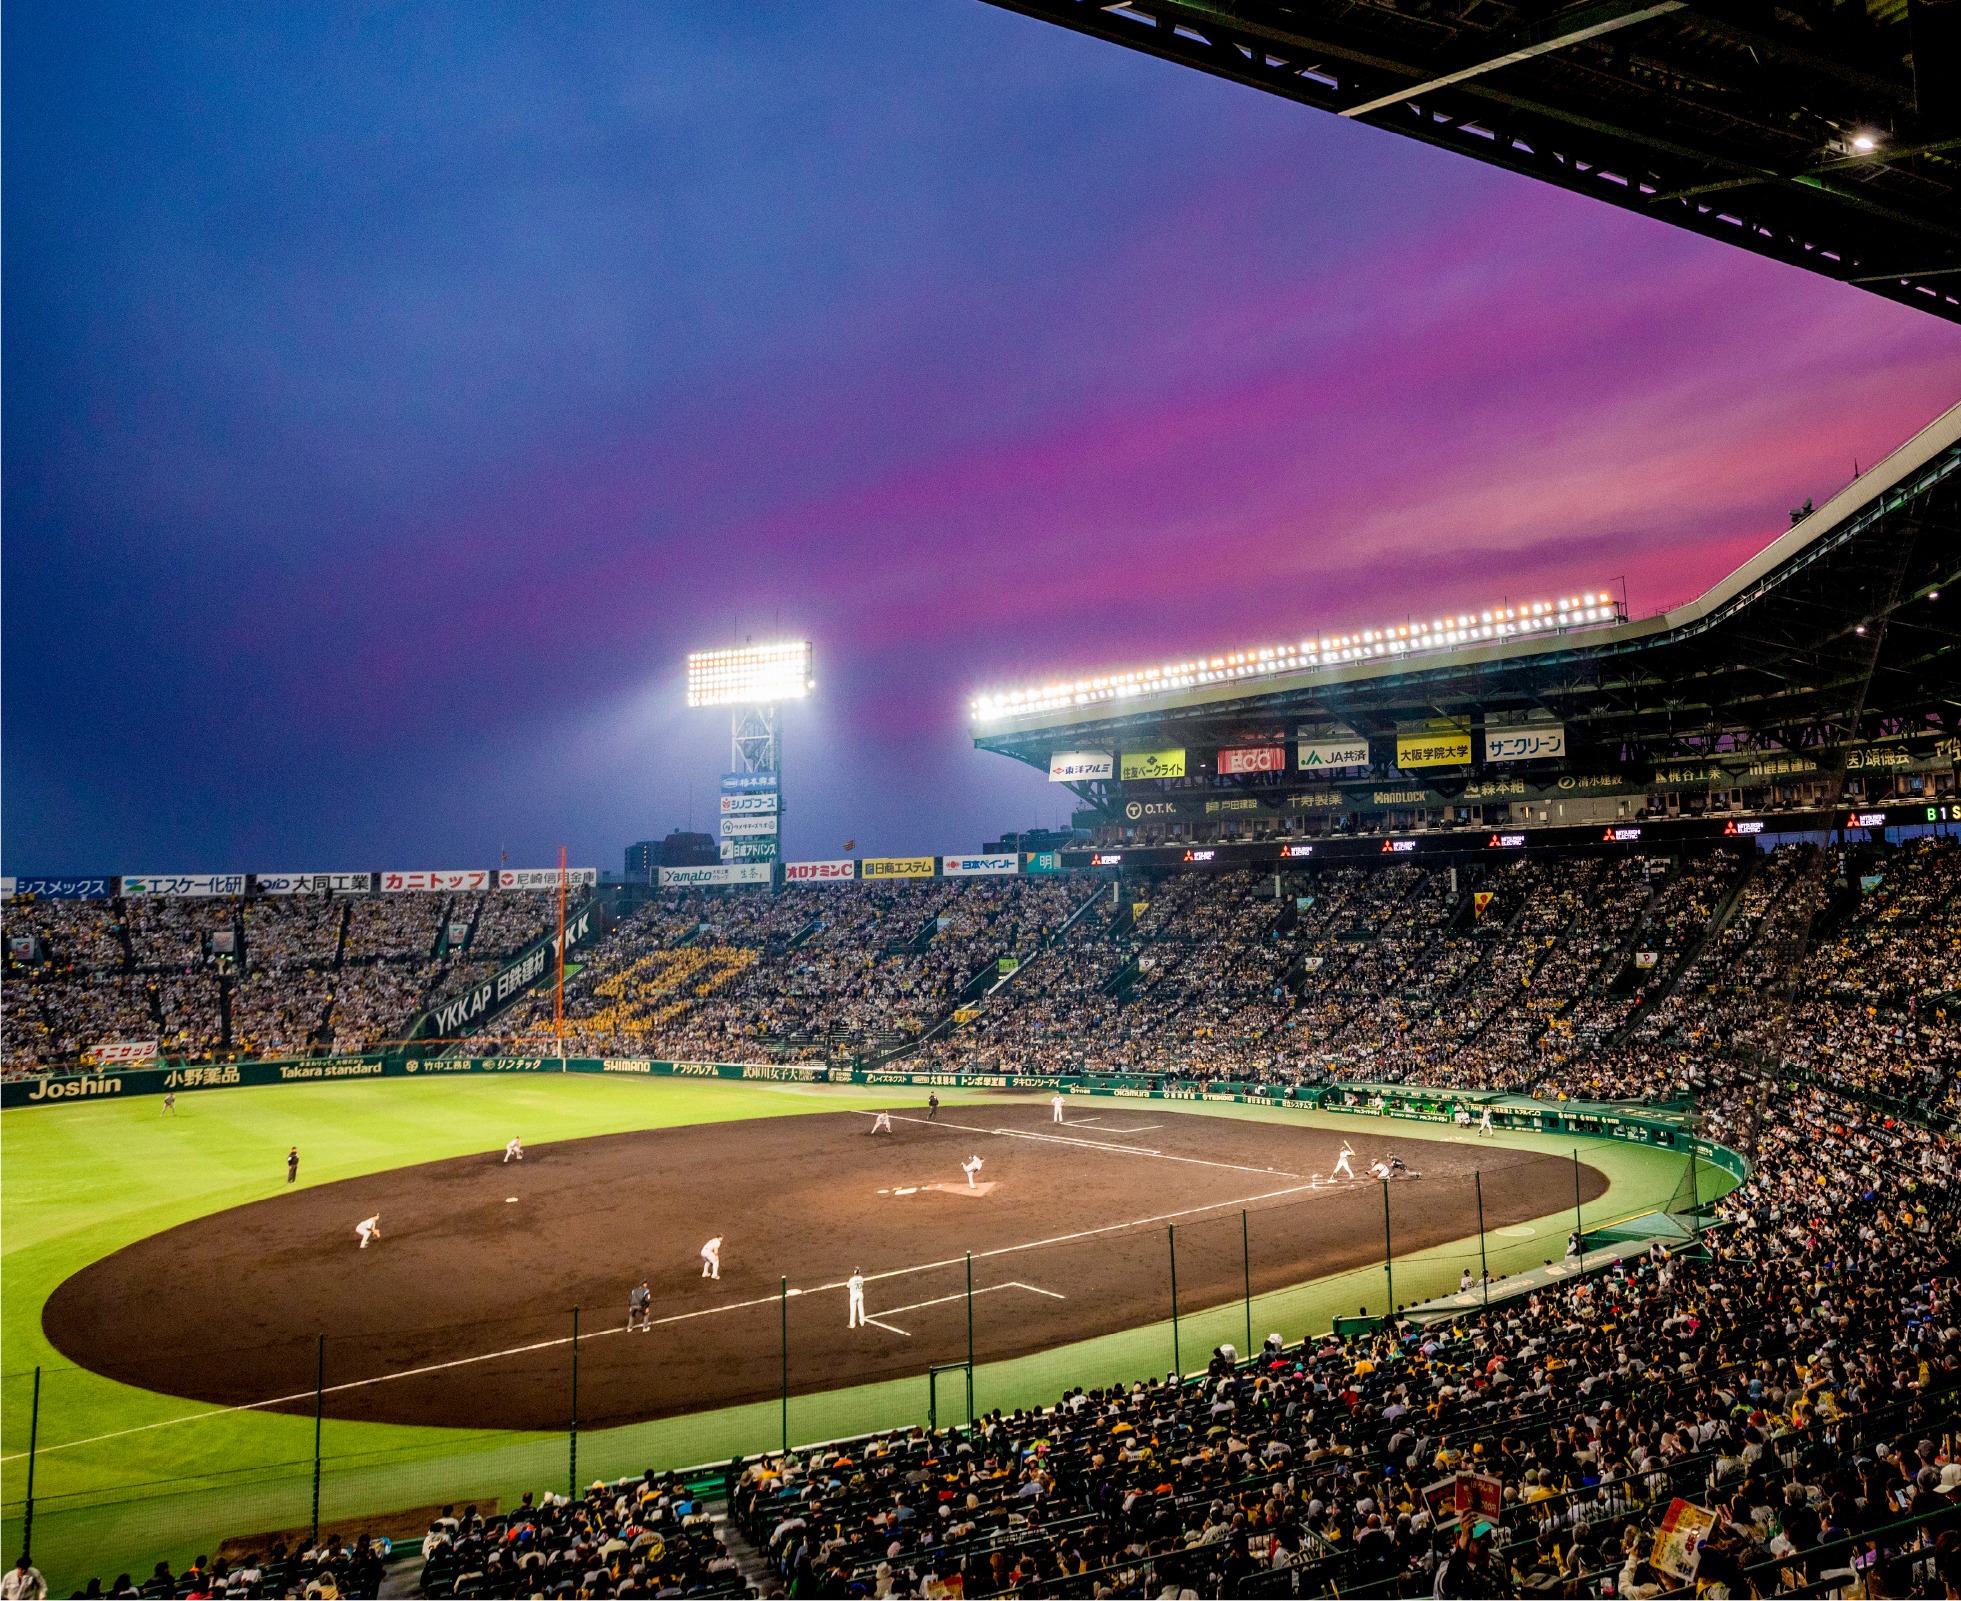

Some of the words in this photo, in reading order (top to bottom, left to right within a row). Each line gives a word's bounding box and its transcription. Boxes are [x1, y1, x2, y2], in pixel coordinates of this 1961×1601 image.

[1400, 745, 1469, 762] 大阪学院大学
[1489, 735, 1561, 756] サニクリーン
[1231, 753, 1271, 771] ECC
[1325, 749, 1367, 764] JA共済
[1065, 763, 1111, 775] 東洋アルミ
[1123, 763, 1183, 780] 住友ベークライト
[1481, 779, 1524, 796] 森本組
[731, 797, 775, 810] シノブフーズ
[1221, 799, 1258, 811] 戸田建設
[1287, 790, 1343, 807] 千寿製薬
[1145, 802, 1176, 814] O.T.K.
[1927, 807, 1937, 821] B
[1940, 807, 1947, 820] 1
[787, 863, 853, 879] オロナミンC
[875, 861, 932, 875] 日商エステム
[962, 859, 1016, 870] 日本ペイント
[293, 875, 370, 892] 大同工業
[386, 872, 486, 890] カニトップ
[517, 870, 595, 887] 尼崎信用金庫
[664, 869, 712, 882] Yamato
[19, 880, 106, 896] シスメックス
[147, 877, 242, 894] エスケー化研
[435, 996, 470, 1037] YKK
[470, 985, 492, 1018] AP
[497, 947, 546, 1003] 日鉄建材
[94, 1044, 156, 1060] 不二サッシ
[280, 1066, 323, 1079] Takara
[324, 1061, 383, 1076] standard
[423, 1060, 472, 1071] 竹中工務店
[497, 1059, 542, 1071] リンテック
[603, 1060, 651, 1072] SHIMANO
[680, 1063, 719, 1076] フジプレアム
[743, 1065, 798, 1081] 武庫川女子大
[164, 1066, 241, 1088] 小野薬品
[873, 1075, 907, 1083] レイズネクスト
[961, 1076, 1007, 1087] トンボ学生服
[1013, 1078, 1061, 1088] タキロンシーアイ
[29, 1074, 122, 1100] Joshin
